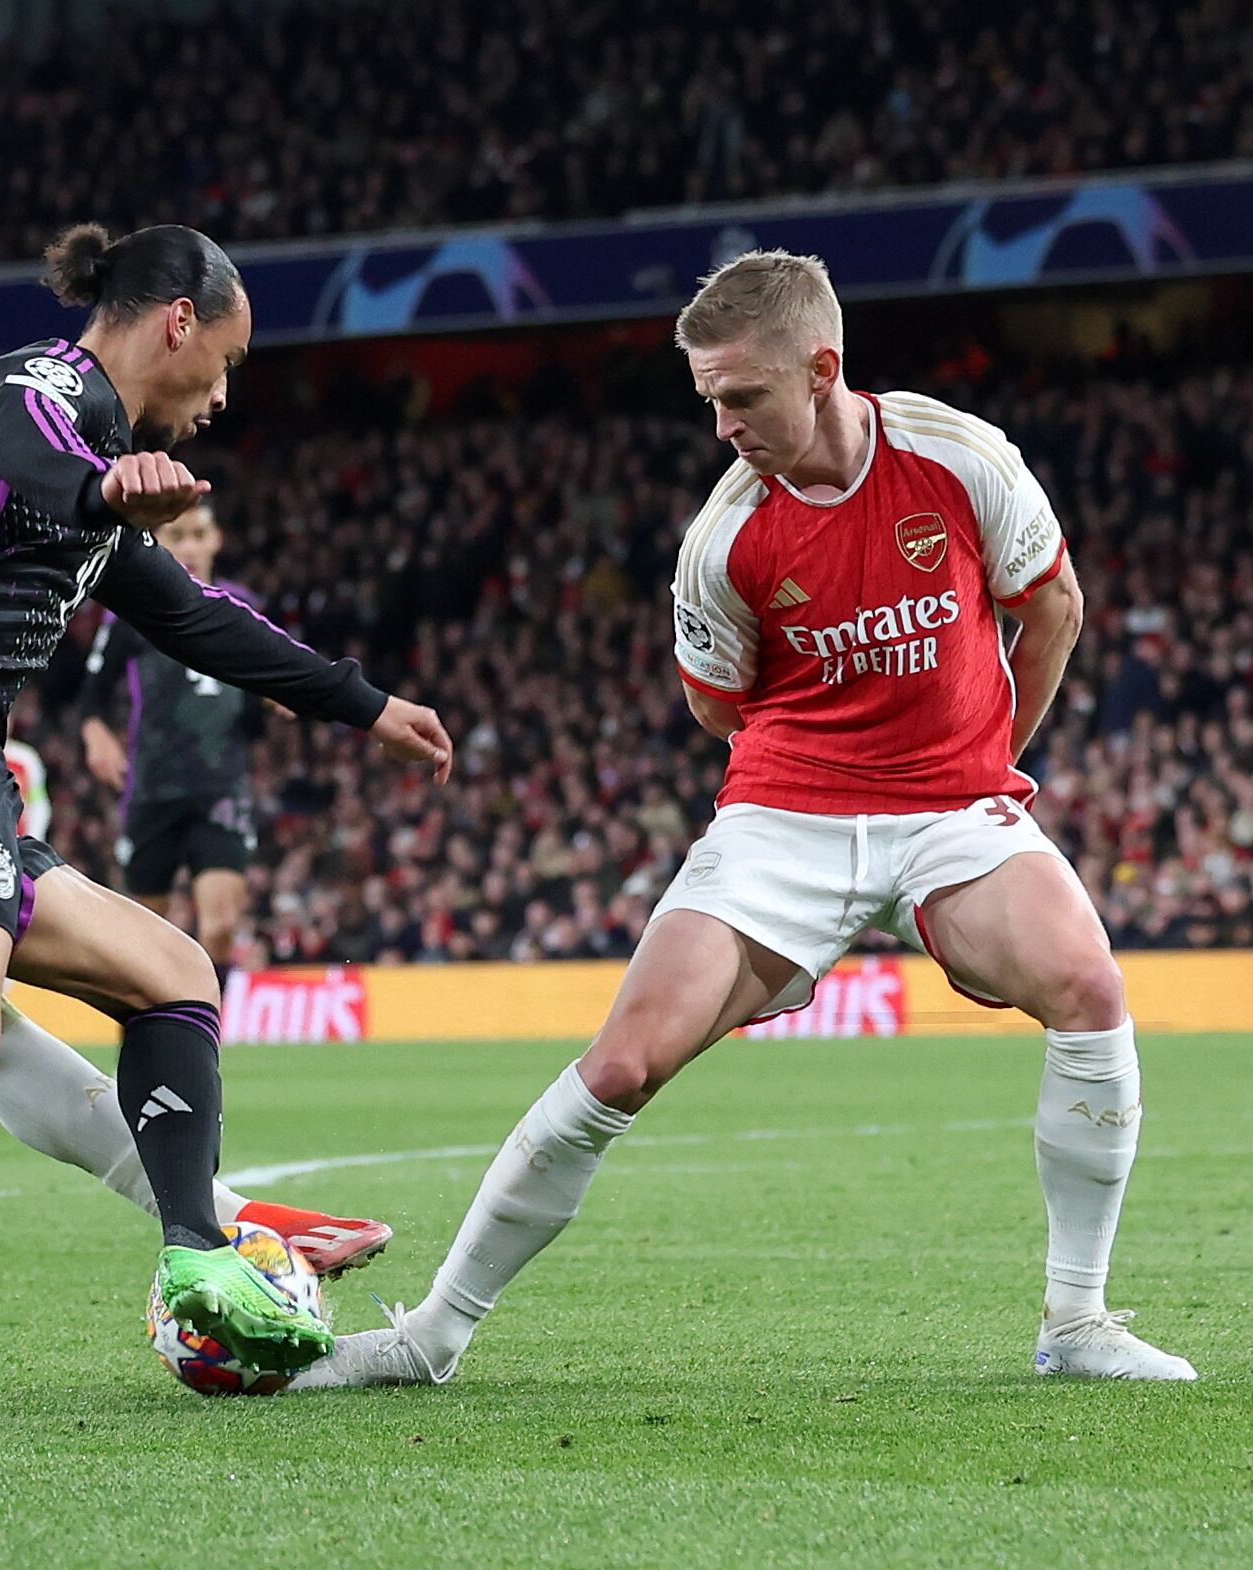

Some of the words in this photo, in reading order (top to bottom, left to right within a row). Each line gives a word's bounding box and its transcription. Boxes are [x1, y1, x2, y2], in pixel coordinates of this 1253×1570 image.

[902, 521, 940, 537] Arsenal
[1016, 508, 1049, 546] VISIT
[1004, 521, 1057, 578] RWAND
[780, 590, 960, 658] Emrates
[852, 637, 938, 676] BETTER
